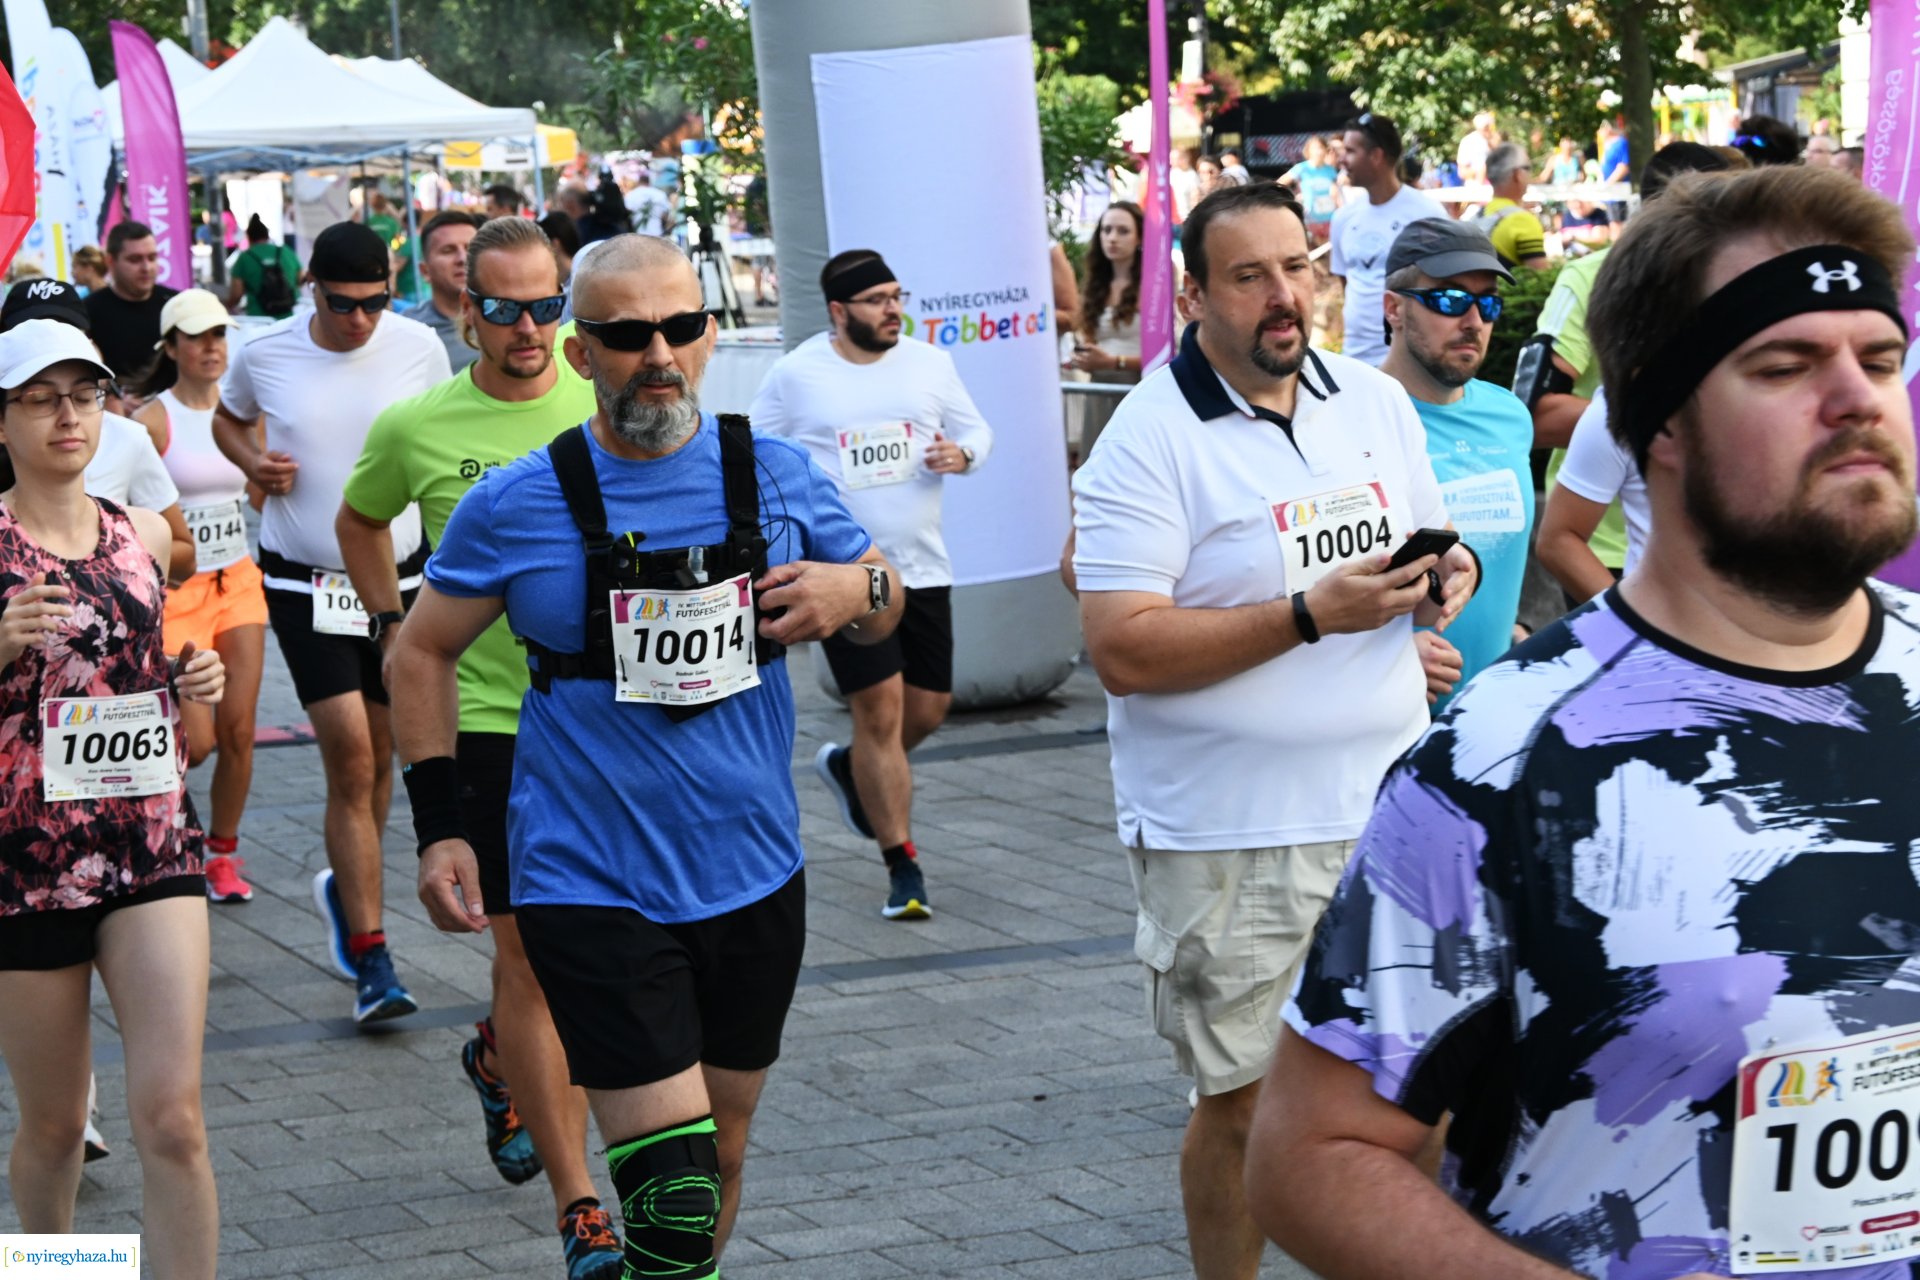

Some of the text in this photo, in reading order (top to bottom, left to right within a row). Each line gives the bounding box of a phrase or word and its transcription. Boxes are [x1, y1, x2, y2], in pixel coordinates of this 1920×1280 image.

[920, 286, 1030, 313] NYÍREGYHÁZA
[922, 311, 1021, 346] Többet
[851, 441, 909, 467] 10001
[1296, 515, 1392, 569] 10004
[676, 601, 732, 619] FUTÓFESZTIVÁL
[633, 614, 744, 666] 10014
[62, 725, 168, 765] 10063
[1765, 1108, 1920, 1193] 100
